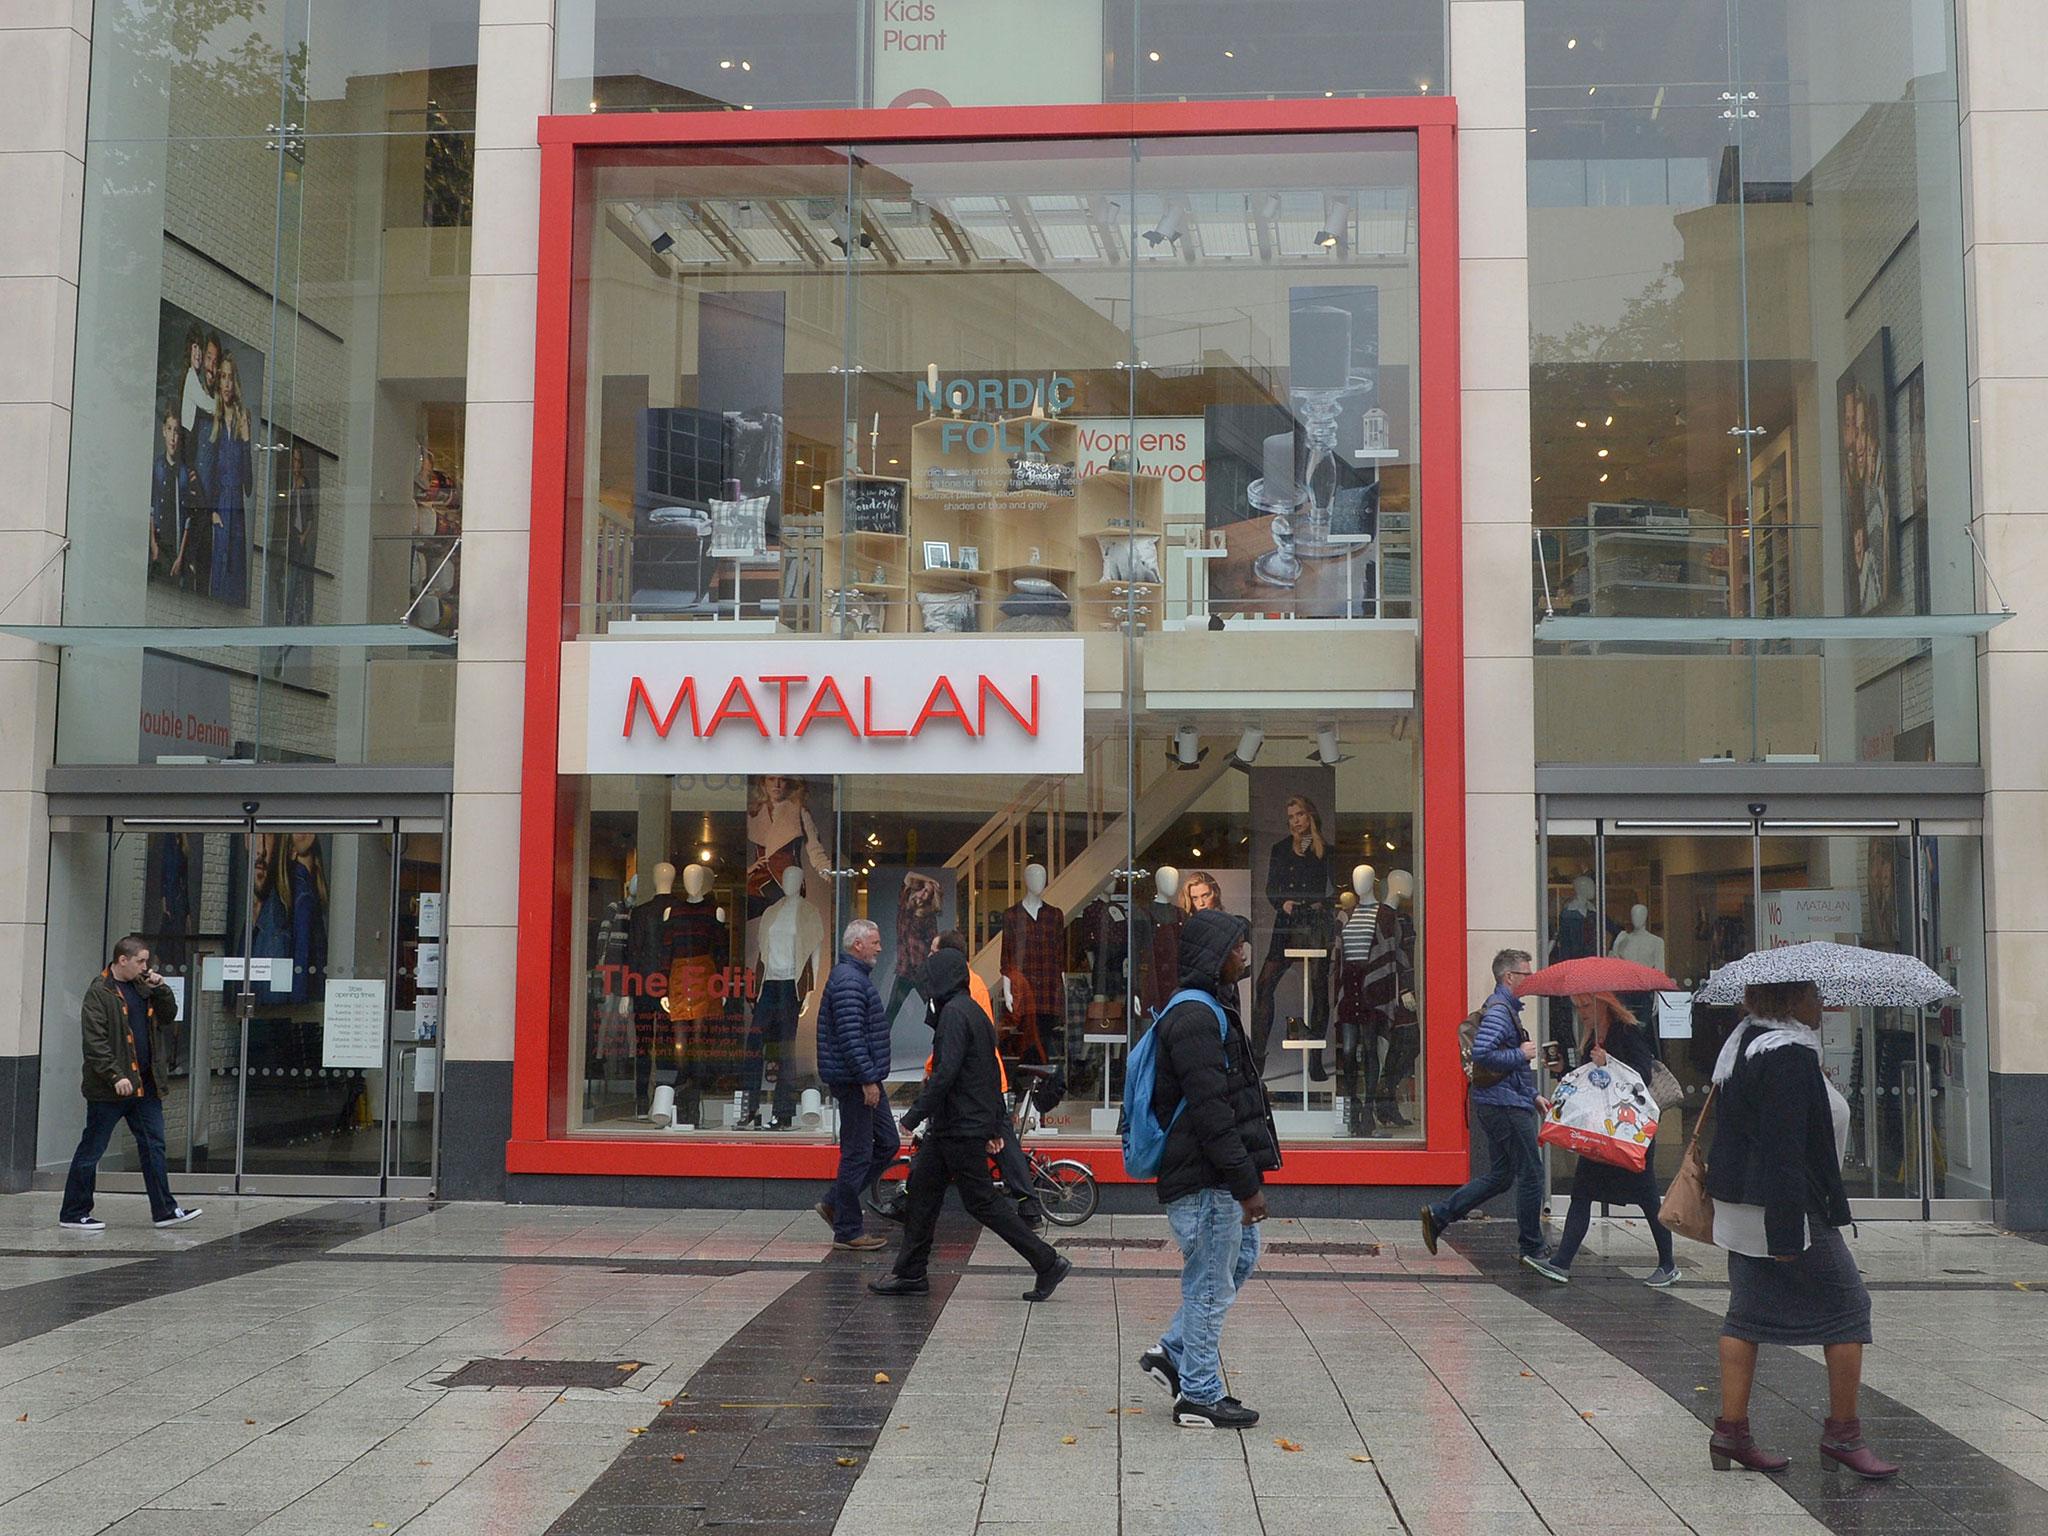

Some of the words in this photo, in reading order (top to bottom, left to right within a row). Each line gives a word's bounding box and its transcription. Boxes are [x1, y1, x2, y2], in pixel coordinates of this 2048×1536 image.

[884, 0, 936, 22] Kids
[883, 29, 947, 51] Plant
[916, 376, 1075, 411] NORDIC
[941, 421, 1051, 454] FOLK
[944, 502, 976, 511] shades
[977, 502, 987, 511] of
[1009, 501, 1027, 511] and
[623, 674, 1040, 738] MATALAN
[140, 708, 182, 739] ouble
[187, 714, 229, 747] Denim
[595, 964, 669, 998] The
[682, 965, 758, 998] Edit
